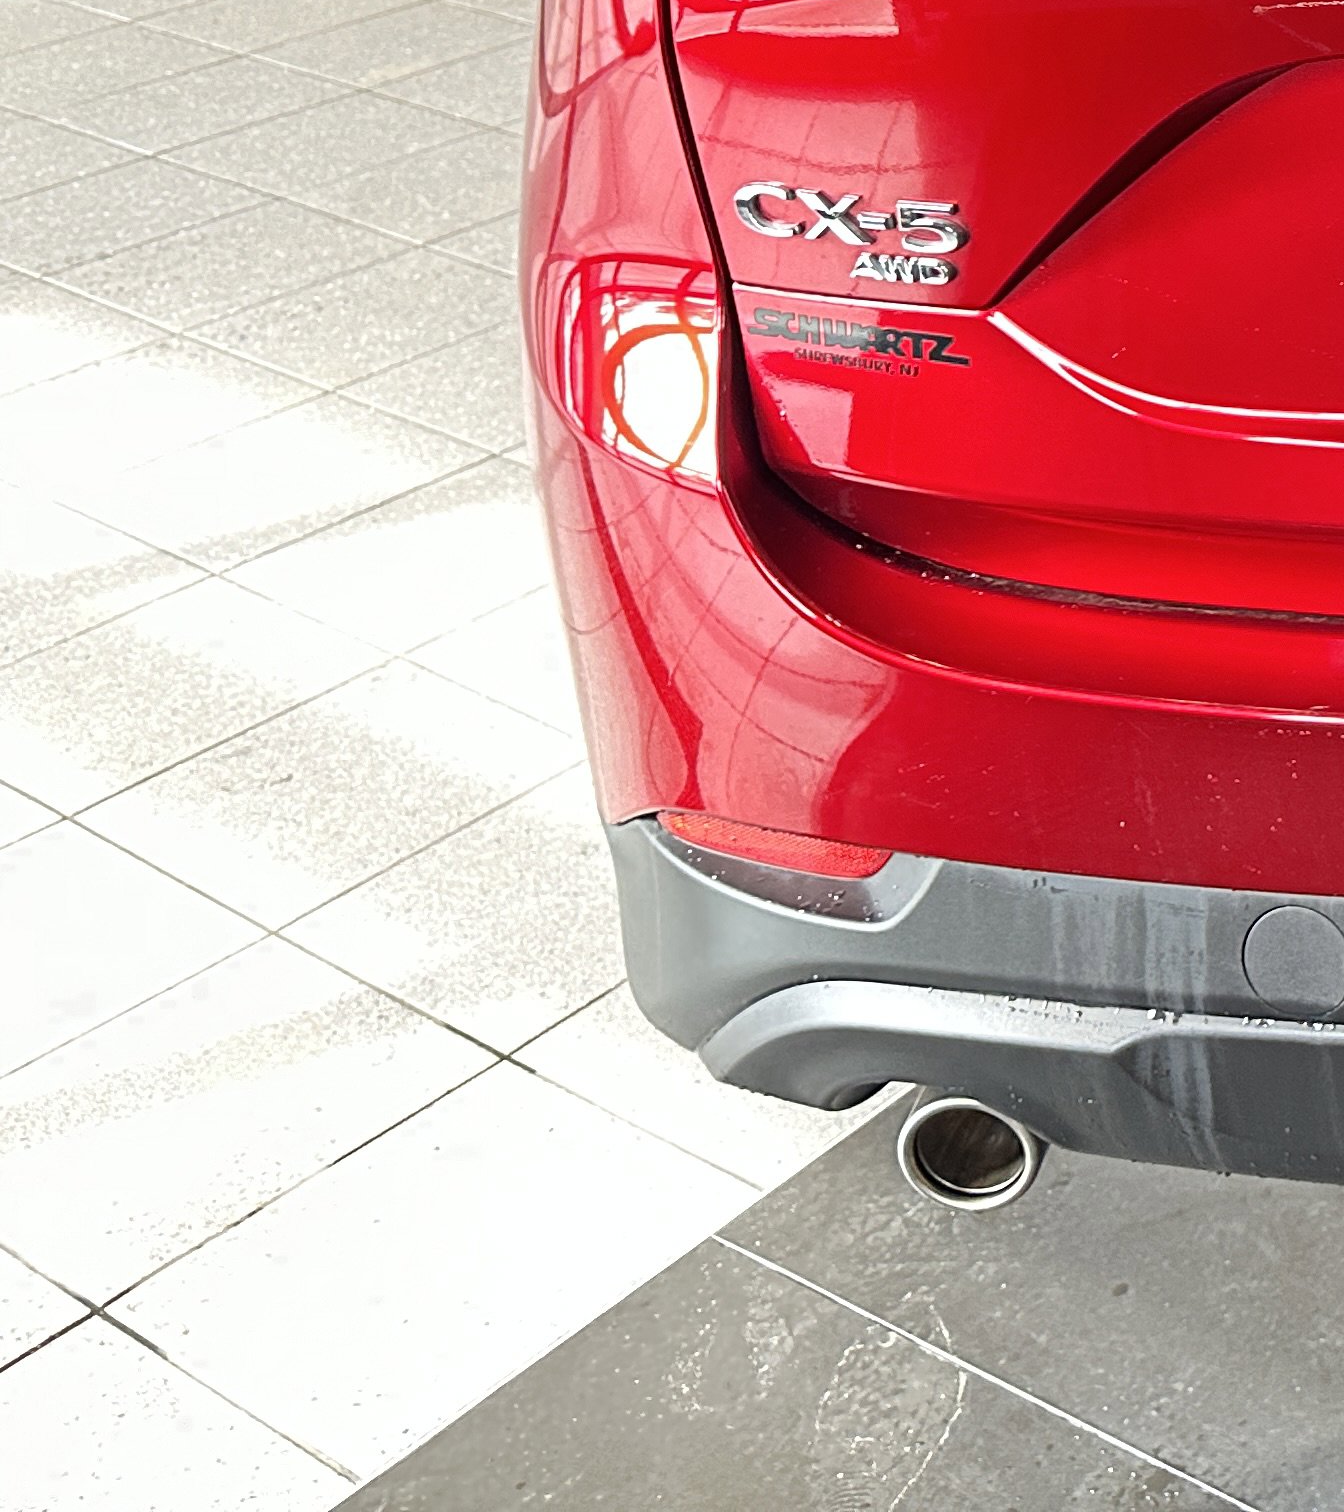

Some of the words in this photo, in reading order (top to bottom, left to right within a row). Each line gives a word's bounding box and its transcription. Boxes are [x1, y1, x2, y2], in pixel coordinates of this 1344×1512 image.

[732, 180, 971, 255] CX-5
[850, 252, 958, 286] AWD
[748, 306, 972, 367] SCHWARTZ
[899, 363, 920, 378] NJ
